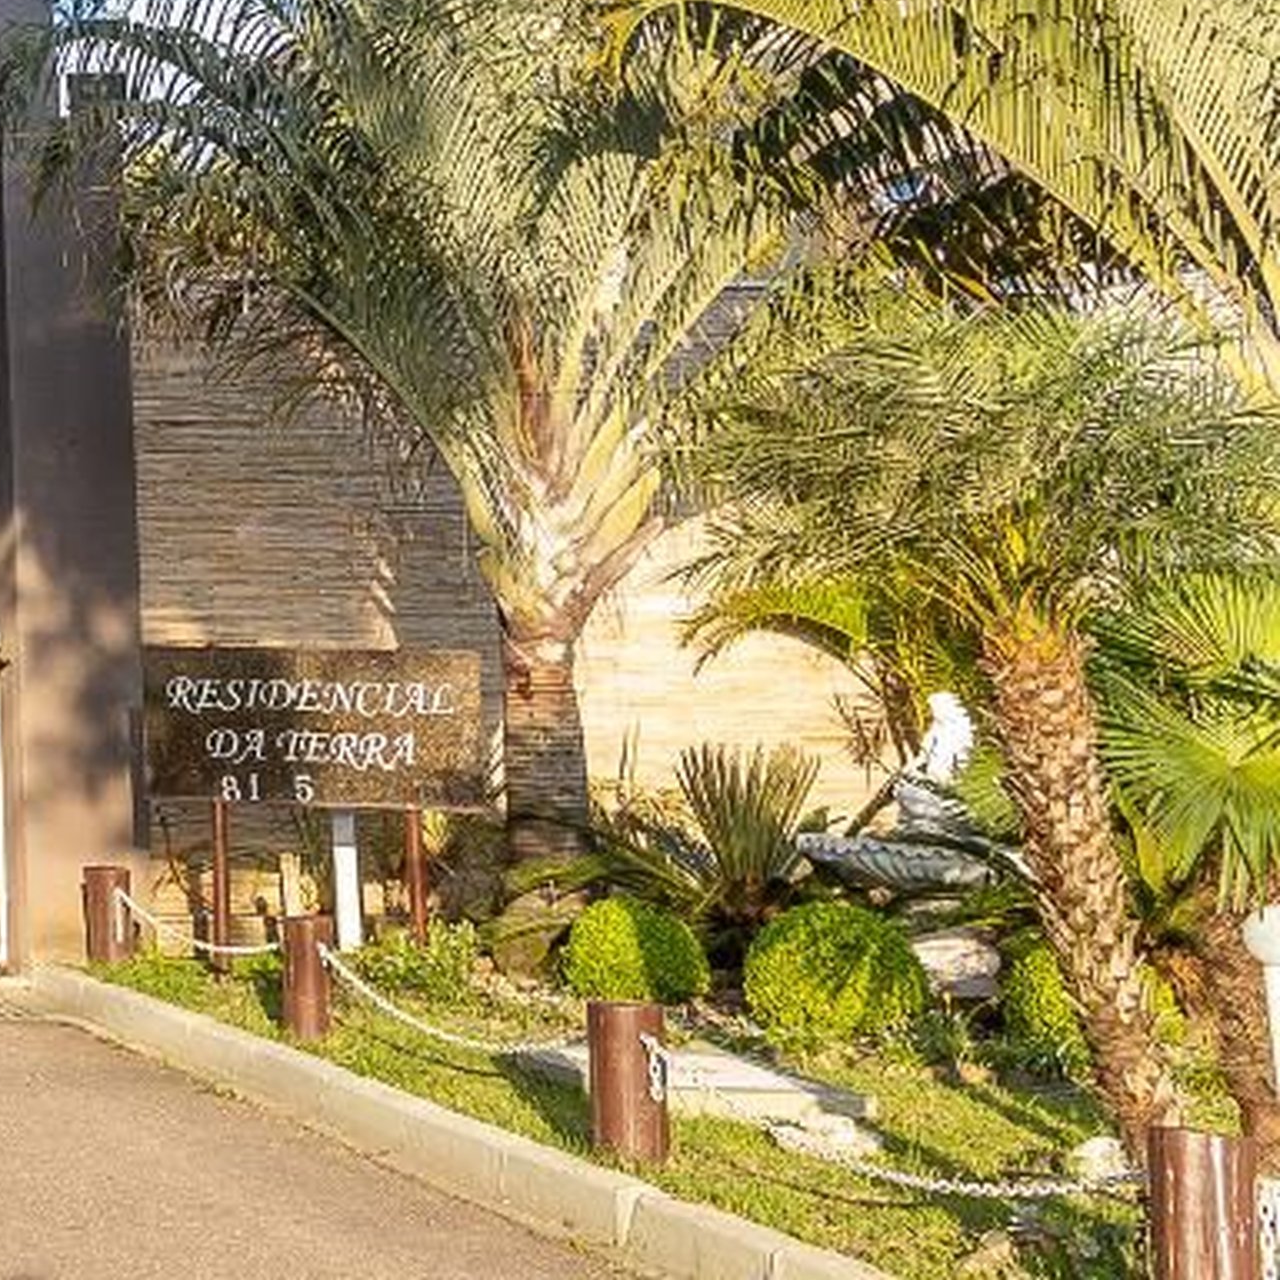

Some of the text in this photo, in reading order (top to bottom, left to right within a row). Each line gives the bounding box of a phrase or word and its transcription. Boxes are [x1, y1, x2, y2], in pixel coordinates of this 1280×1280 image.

[166, 674, 456, 716] RESIDENCIAL
[206, 729, 417, 771] DA TERRA
